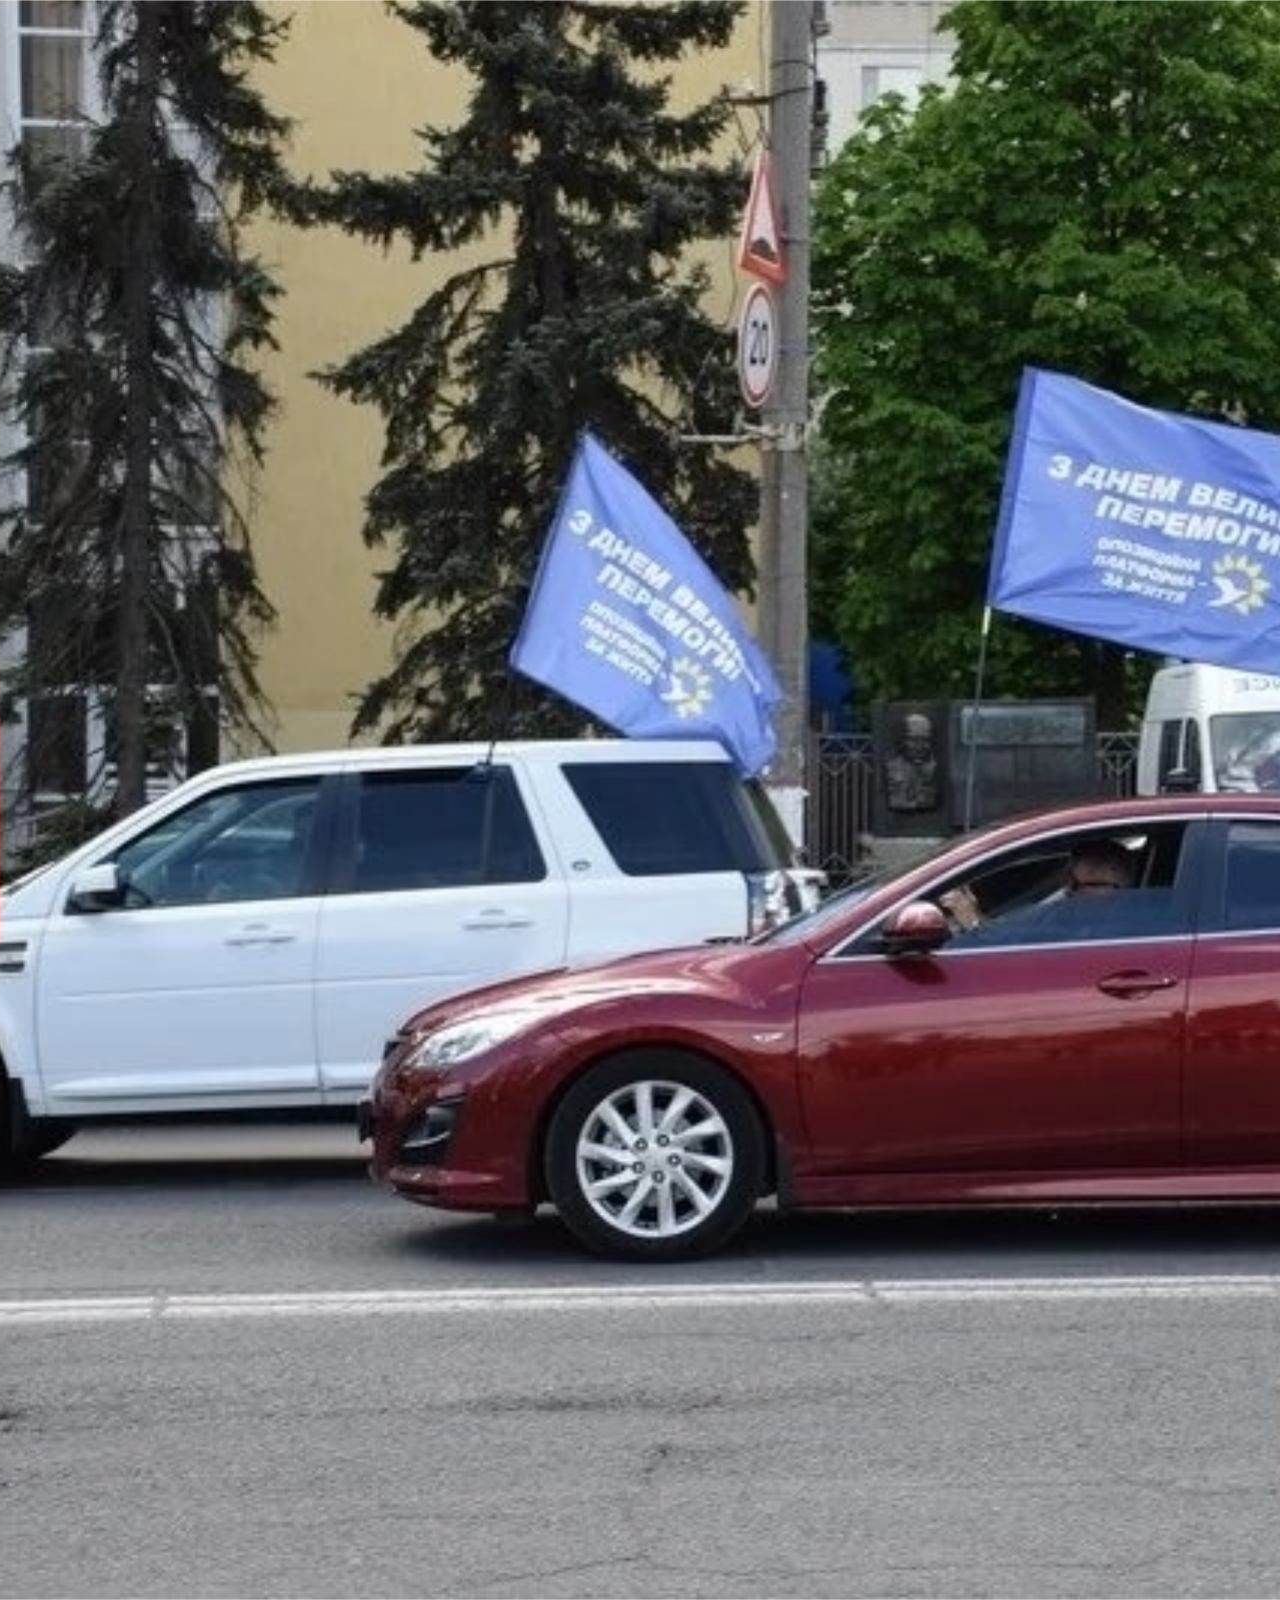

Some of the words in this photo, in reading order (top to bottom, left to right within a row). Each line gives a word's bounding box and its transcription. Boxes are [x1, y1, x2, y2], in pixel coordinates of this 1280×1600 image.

[749, 319, 768, 367] 20
[1048, 455, 1073, 479] З
[1075, 463, 1183, 502] ДНЕМ
[1187, 482, 1280, 530] ВЕЛИ
[570, 509, 593, 536] З
[588, 527, 673, 591] ДНЕМ
